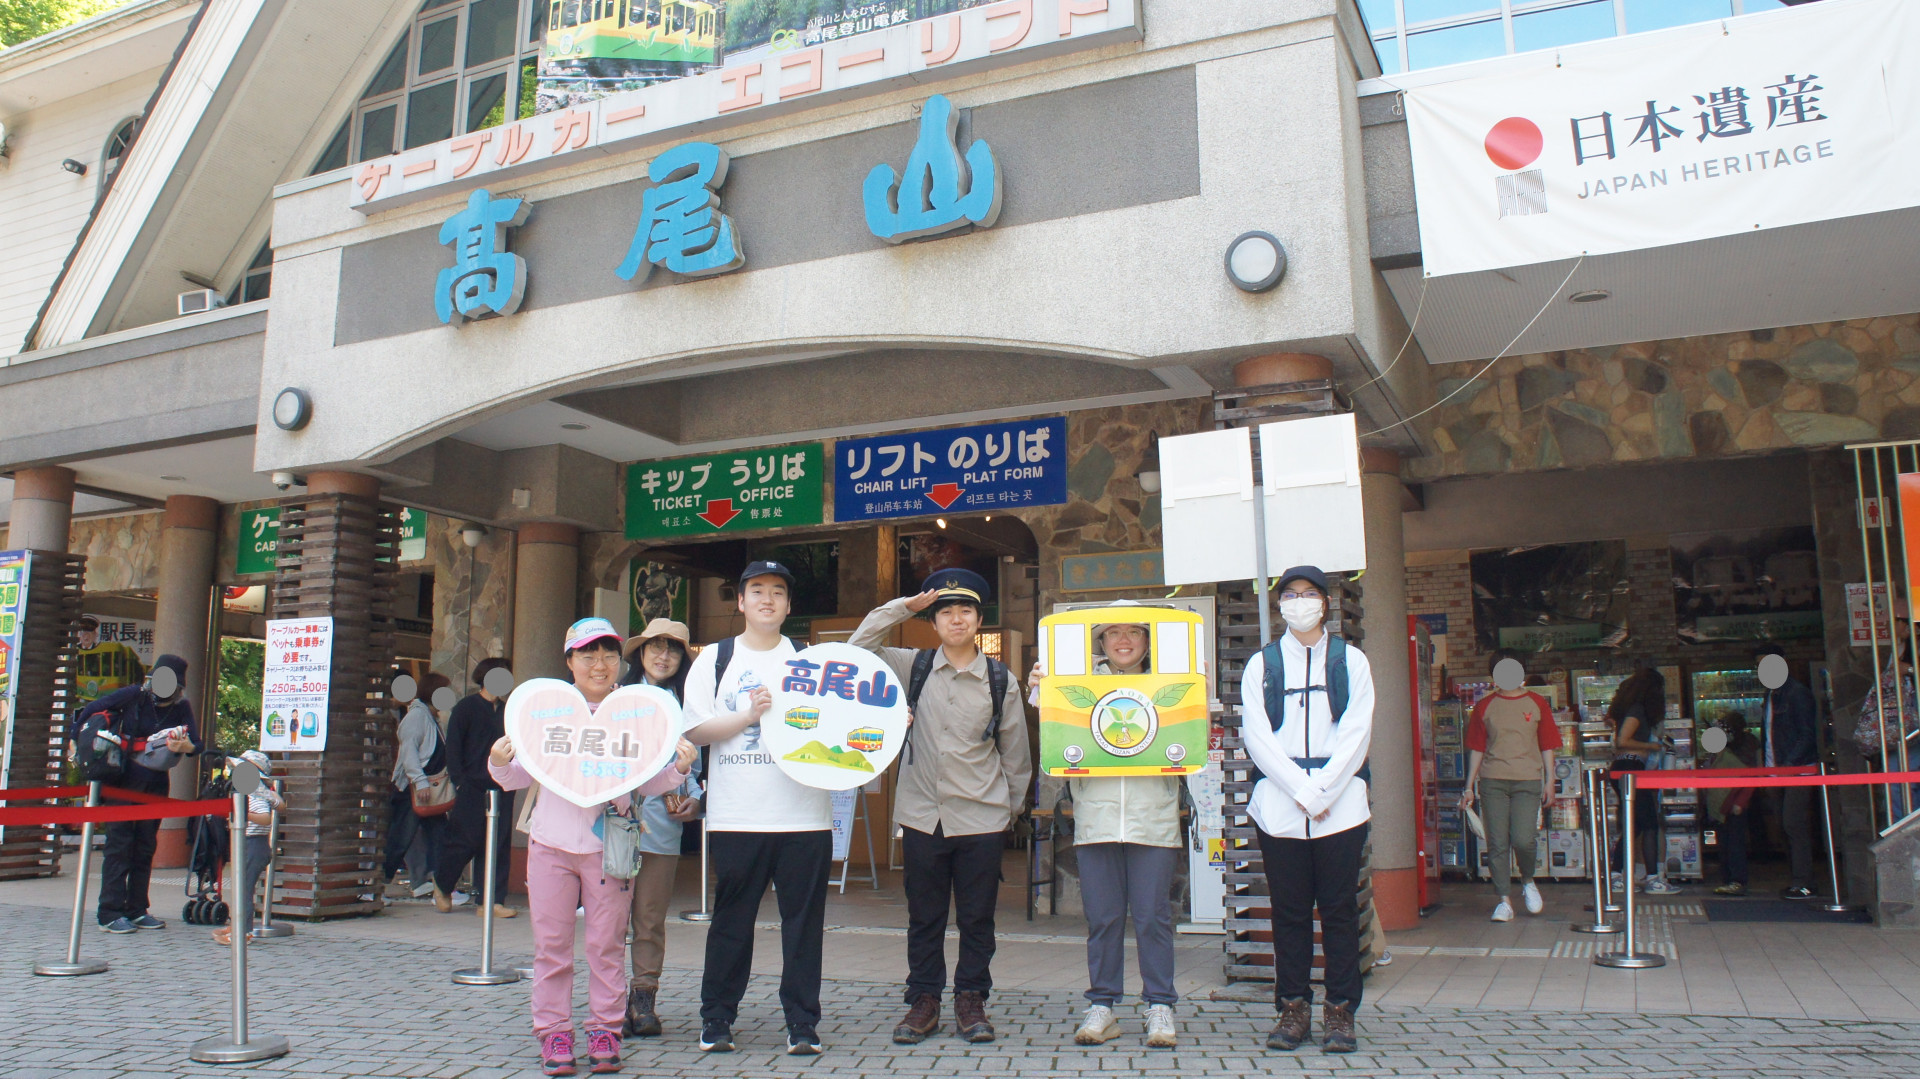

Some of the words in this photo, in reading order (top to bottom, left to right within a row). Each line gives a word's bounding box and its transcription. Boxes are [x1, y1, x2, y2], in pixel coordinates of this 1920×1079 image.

[805, 8, 909, 45] 高尾登山電鉄
[357, 105, 646, 202] ケーブルカー
[718, 0, 1109, 113] エコーリフト
[1569, 73, 1829, 167] 日本遺産
[1577, 168, 1668, 200] JAPAN
[1681, 138, 1835, 182] HERITAGE
[847, 441, 936, 480] リフト
[947, 426, 1051, 469] のりば
[641, 461, 713, 495] キップ
[729, 451, 806, 487] うりば
[854, 480, 893, 494] CHAIR
[900, 477, 928, 490] LIFT
[963, 470, 997, 484] PLAT
[1004, 466, 1043, 480] FORM
[652, 494, 702, 511] TICKET
[739, 485, 795, 502] OFFICE
[966, 492, 995, 505] 리프트
[999, 490, 1020, 503] 타는
[1023, 488, 1033, 501] 곳
[750, 507, 783, 520] 售票处
[100, 622, 154, 645] 駅長推
[271, 624, 329, 635] ケーブルカー乗車には
[282, 651, 312, 663] 必要です。
[781, 658, 899, 708] 高尾山
[1119, 689, 1150, 707] AOBA
[543, 725, 640, 759] 高尾山
[1094, 730, 1109, 749] TAKAO
[1133, 729, 1155, 753] DENTETSU
[718, 753, 777, 765] GHOSTBU
